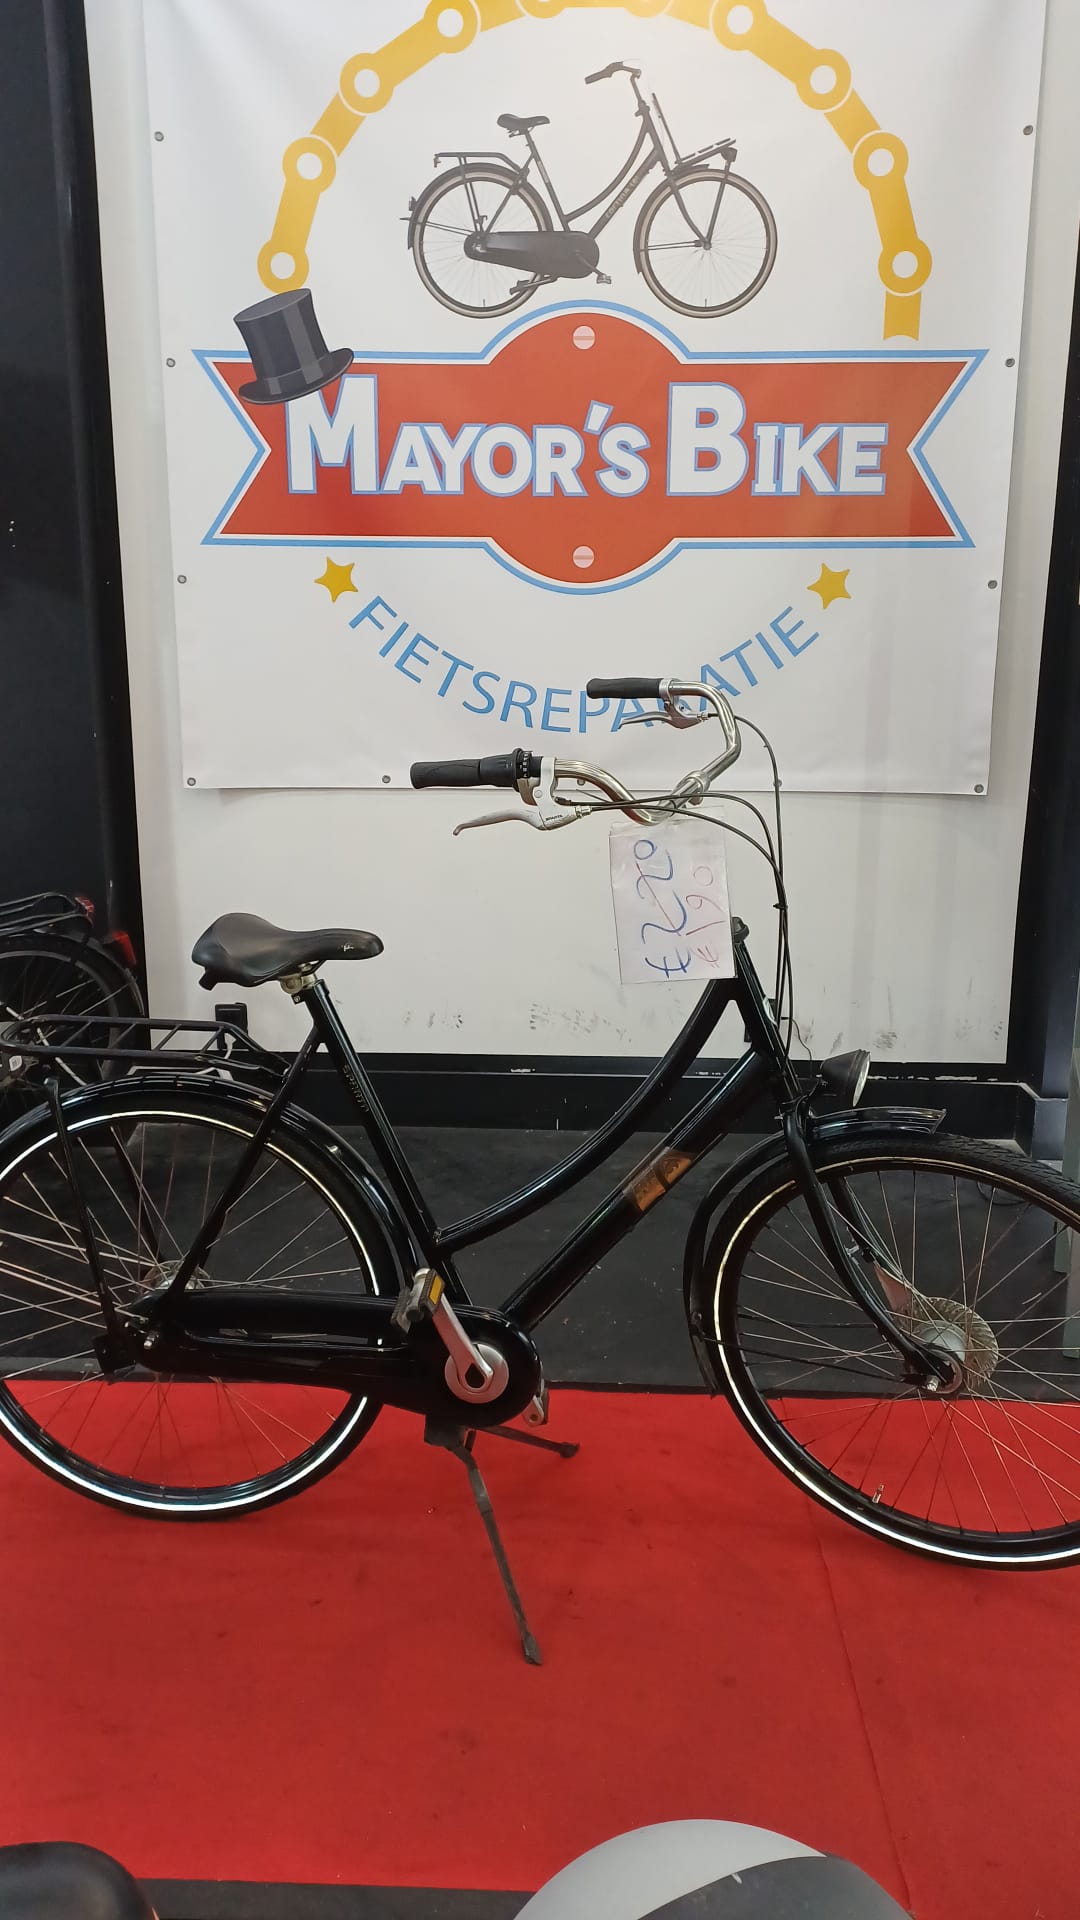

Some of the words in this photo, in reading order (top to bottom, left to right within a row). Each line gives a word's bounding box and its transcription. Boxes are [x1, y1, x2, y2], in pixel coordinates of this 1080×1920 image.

[285, 374, 651, 497] MAYOR'S
[667, 381, 889, 497] BIKE
[348, 595, 820, 734] FIETSREPAATIE
